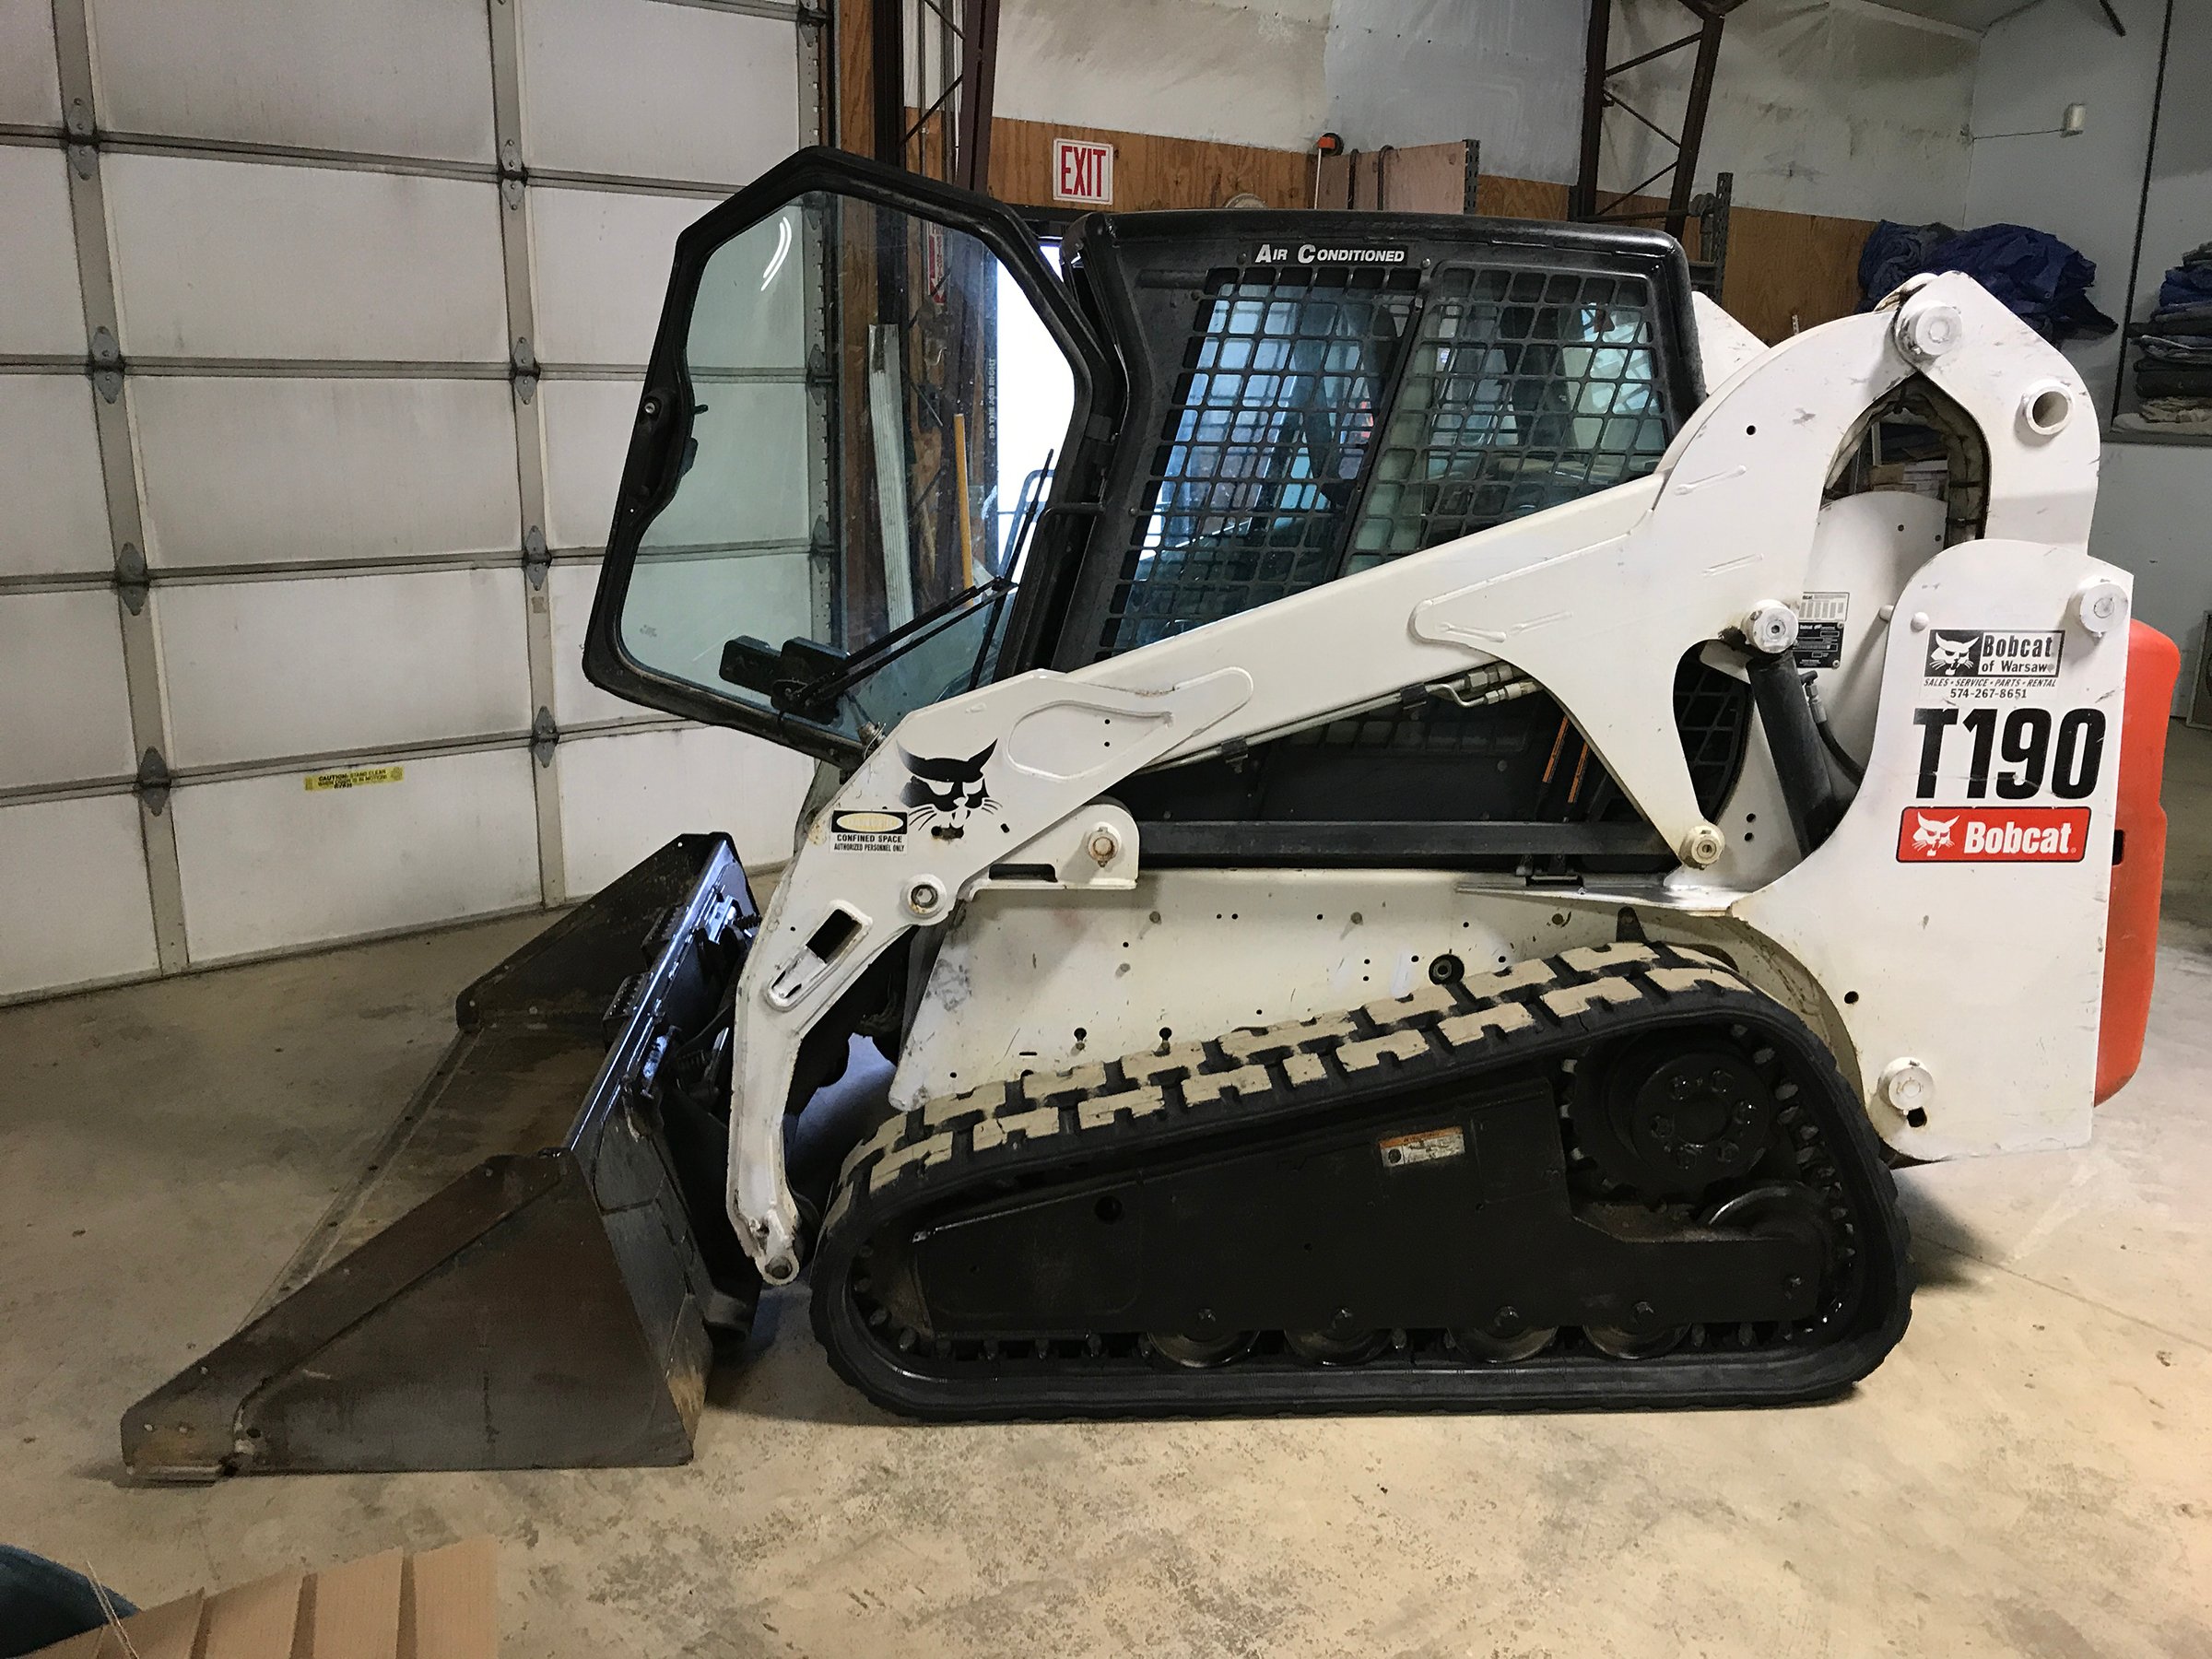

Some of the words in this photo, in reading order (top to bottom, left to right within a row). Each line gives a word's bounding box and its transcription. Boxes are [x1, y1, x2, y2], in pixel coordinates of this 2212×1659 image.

[1061, 145, 1107, 197] EXIT
[1254, 243, 1288, 264] AIR
[1298, 243, 1405, 265] CONDITIONED
[1983, 635, 2053, 658] Bobcat
[1982, 660, 1994, 673] of
[2001, 660, 2047, 673] Warsaw
[1924, 678, 1950, 688] SALES
[1955, 678, 1991, 688] SERVICE
[1994, 678, 2020, 688] PARTS
[2027, 678, 2056, 688] RENTAL
[1950, 688, 2028, 699] 574-267-8651
[1912, 708, 2106, 800] T190
[837, 834, 876, 842] CONFINED
[877, 835, 902, 843] SPACE
[1963, 821, 2072, 854] Bobcat
[834, 842, 864, 852] AUTHORIZED
[864, 843, 891, 852] PERSONNEL
[892, 844, 905, 853] ONLY
